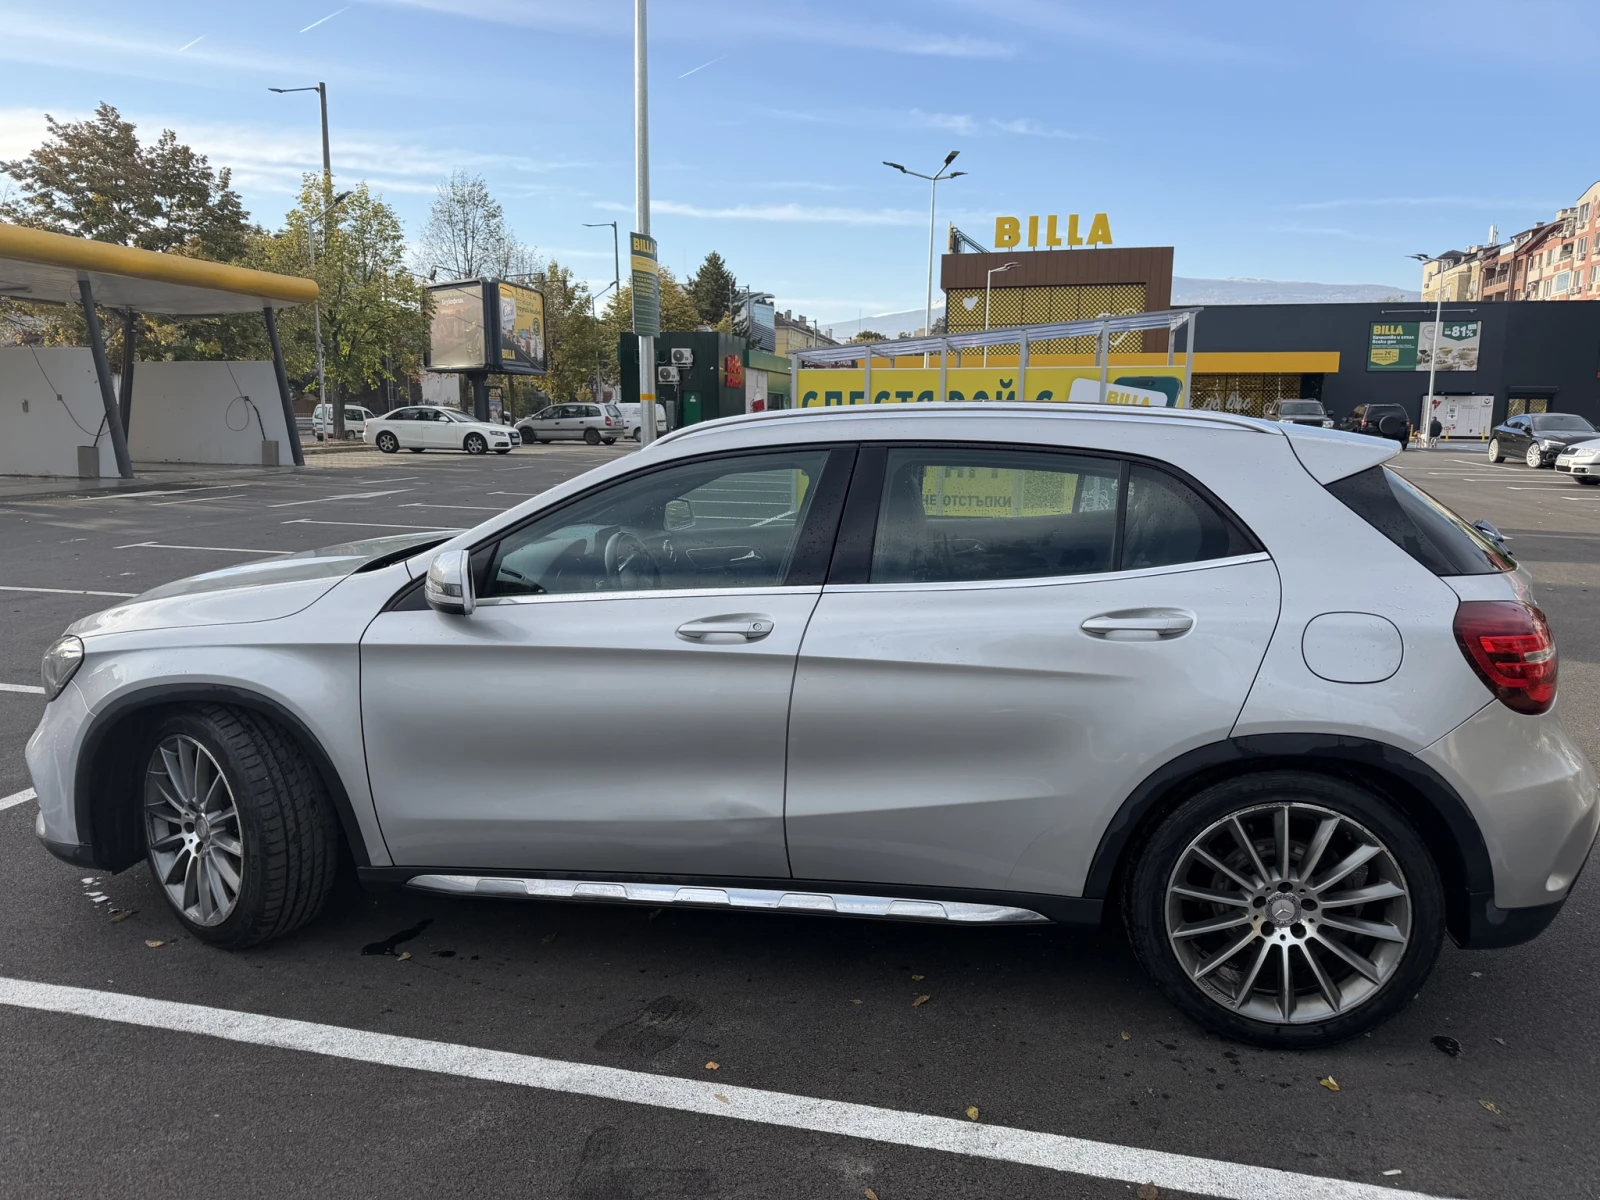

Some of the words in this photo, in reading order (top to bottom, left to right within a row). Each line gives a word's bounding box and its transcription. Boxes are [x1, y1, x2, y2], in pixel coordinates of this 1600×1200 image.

[994, 213, 1112, 248] BILLA
[633, 237, 653, 254] BILLA
[1373, 325, 1403, 335] BILLA
[502, 348, 516, 360] BILLA
[942, 495, 1013, 508] ОТСТЪПКИ
